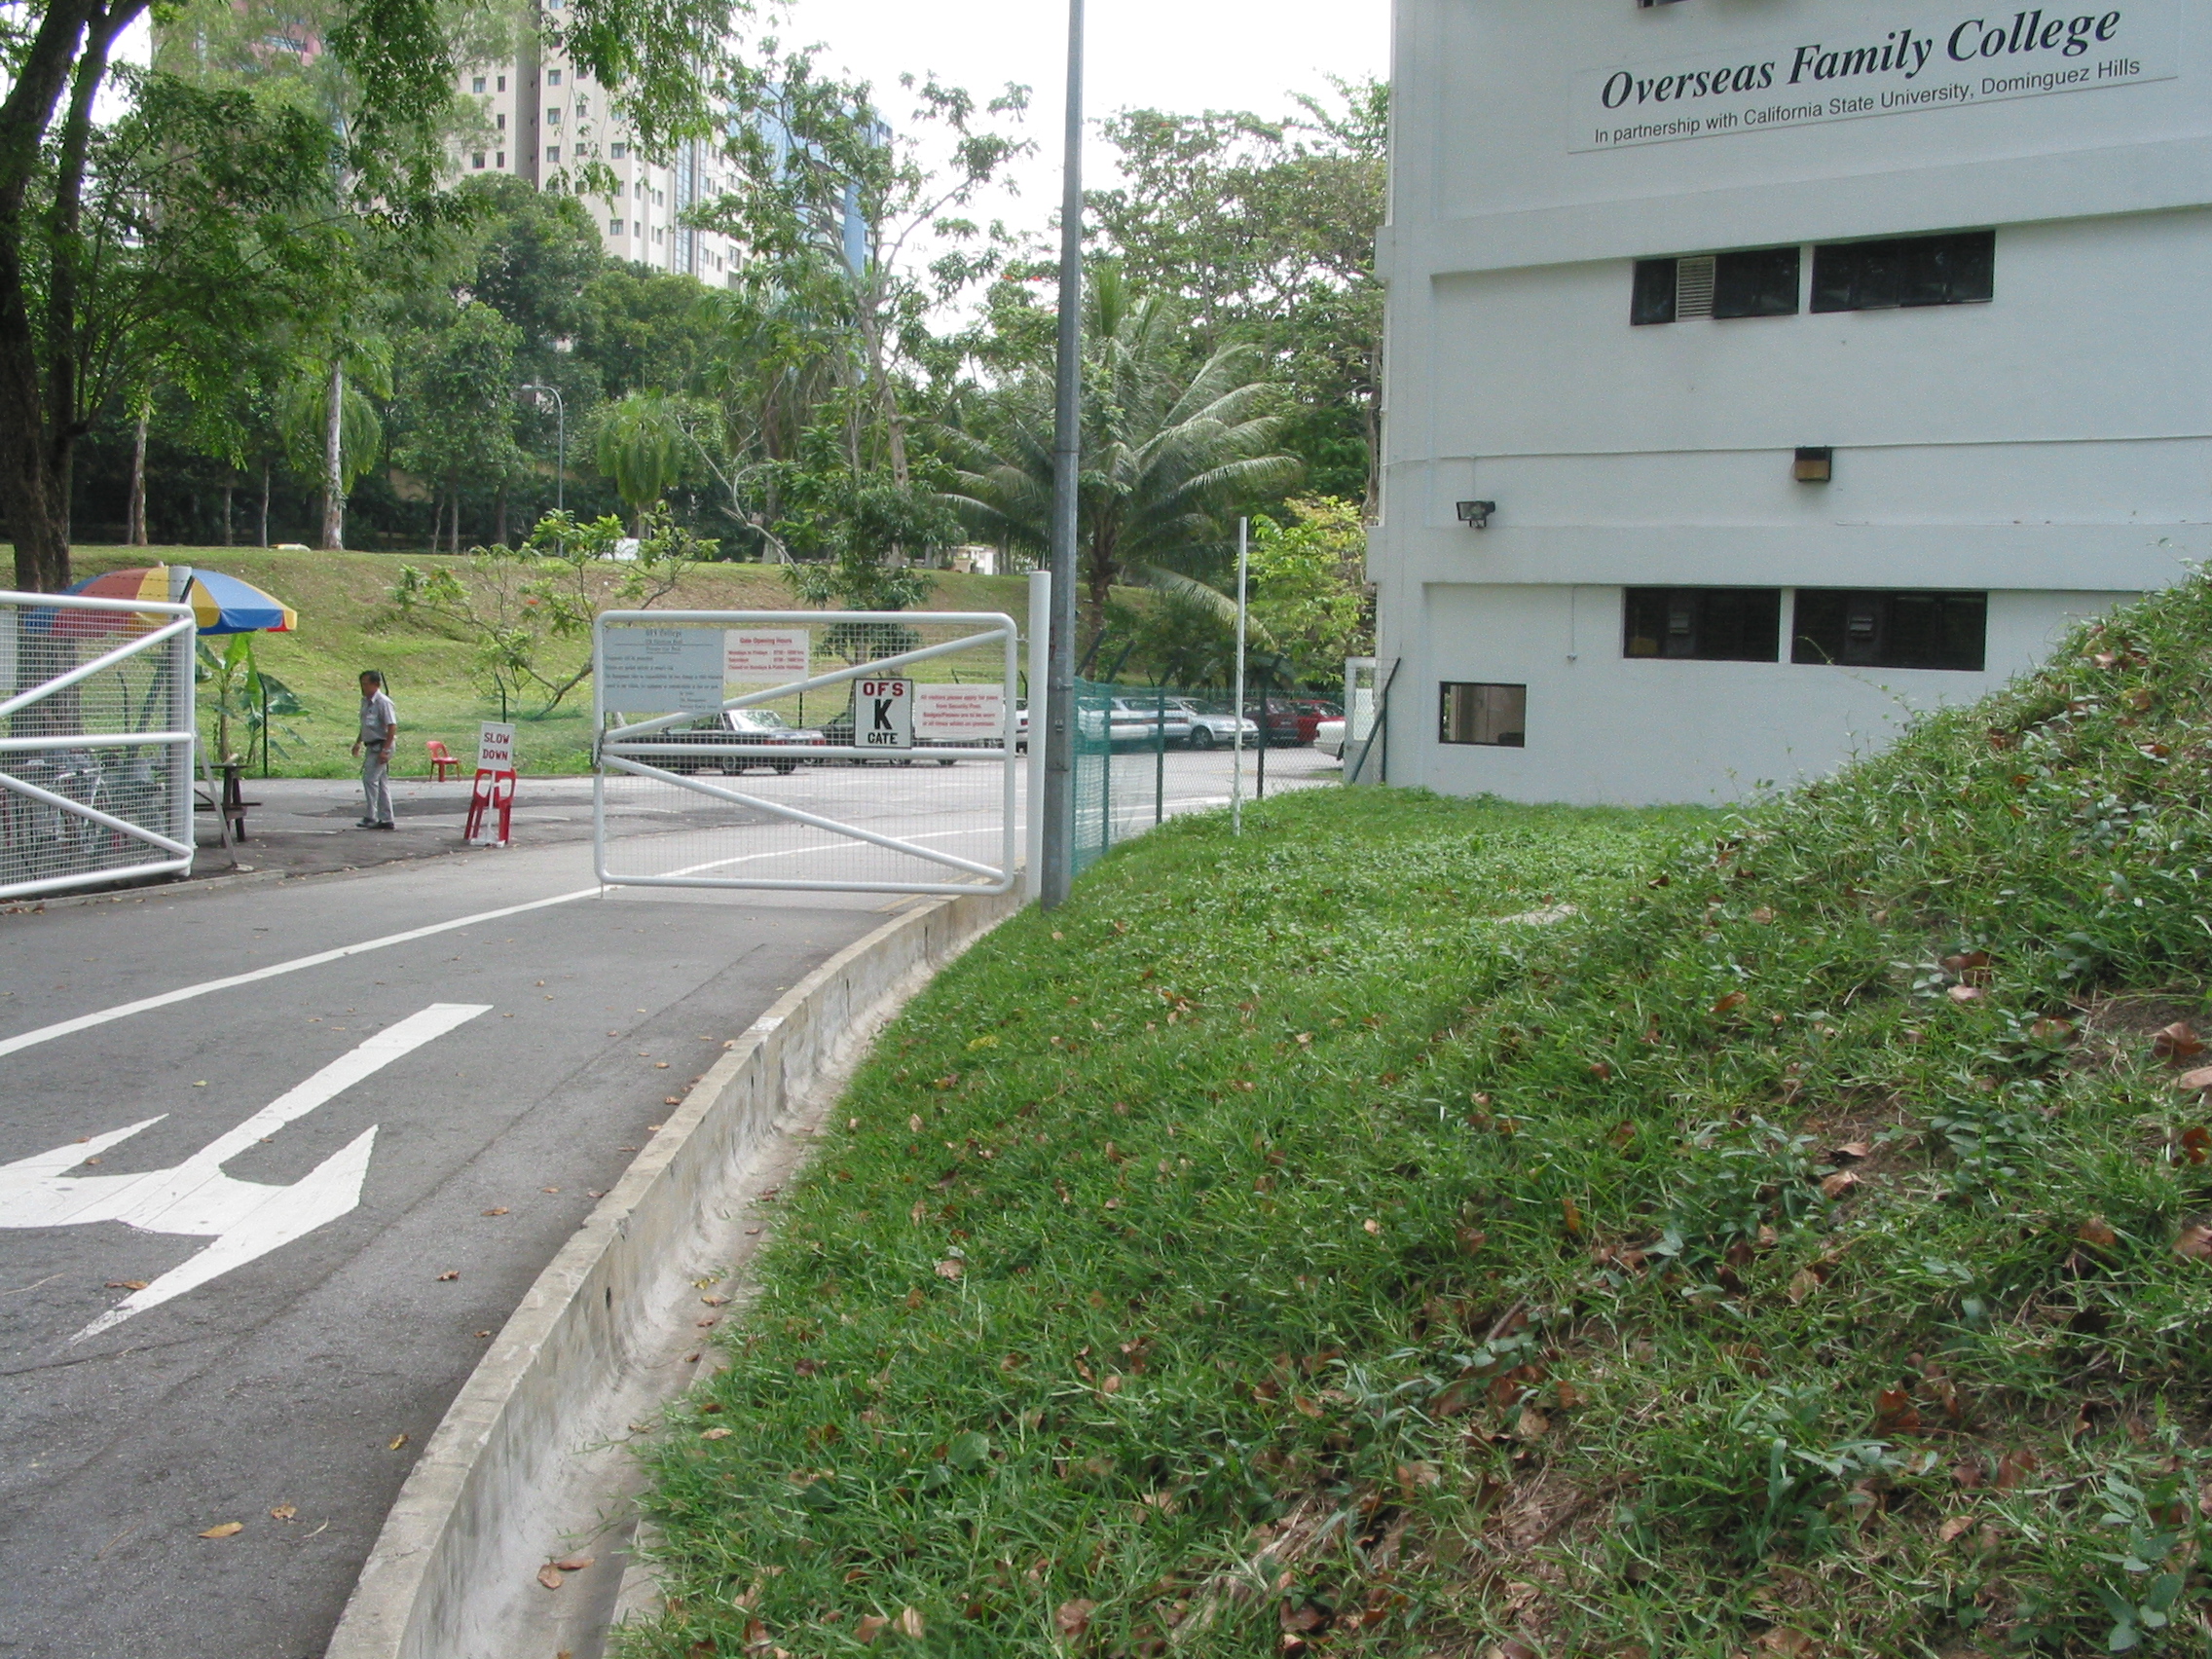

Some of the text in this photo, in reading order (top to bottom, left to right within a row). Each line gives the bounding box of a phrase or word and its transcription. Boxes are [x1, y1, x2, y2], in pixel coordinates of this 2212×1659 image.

[1602, 9, 2121, 109] Overseas Family College
[1596, 58, 2141, 144] In partnership with California State University, Dominguez Hills
[874, 699, 893, 730] K
[484, 732, 510, 744] SLOW
[867, 732, 898, 745] GATE
[483, 749, 508, 760] DOWN
